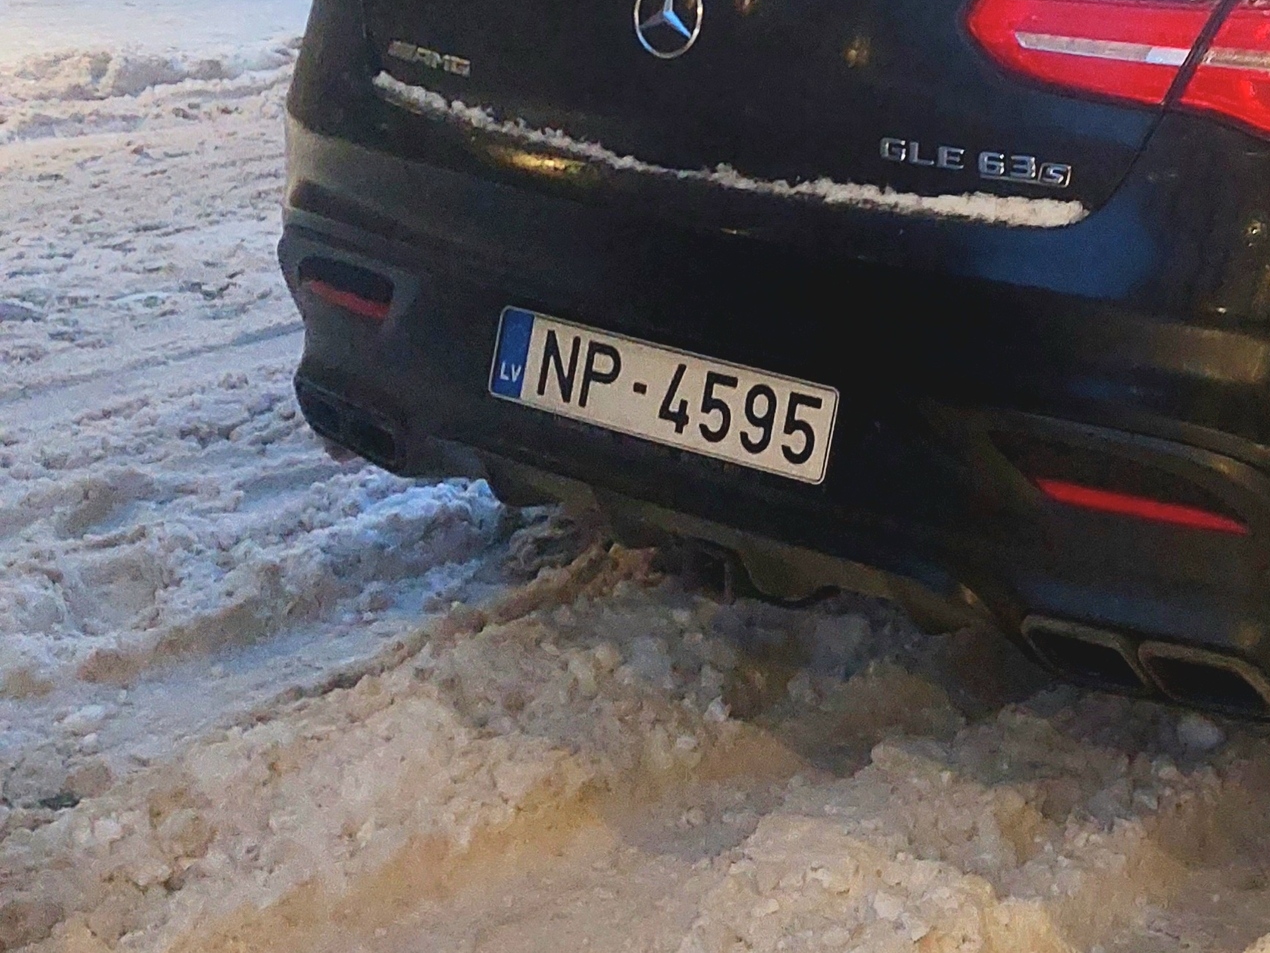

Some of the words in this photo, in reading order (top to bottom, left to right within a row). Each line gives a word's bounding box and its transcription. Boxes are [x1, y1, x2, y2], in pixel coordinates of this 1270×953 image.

[879, 137, 965, 170] GLE
[499, 360, 522, 383] LV
[536, 329, 823, 465] NP-4595
